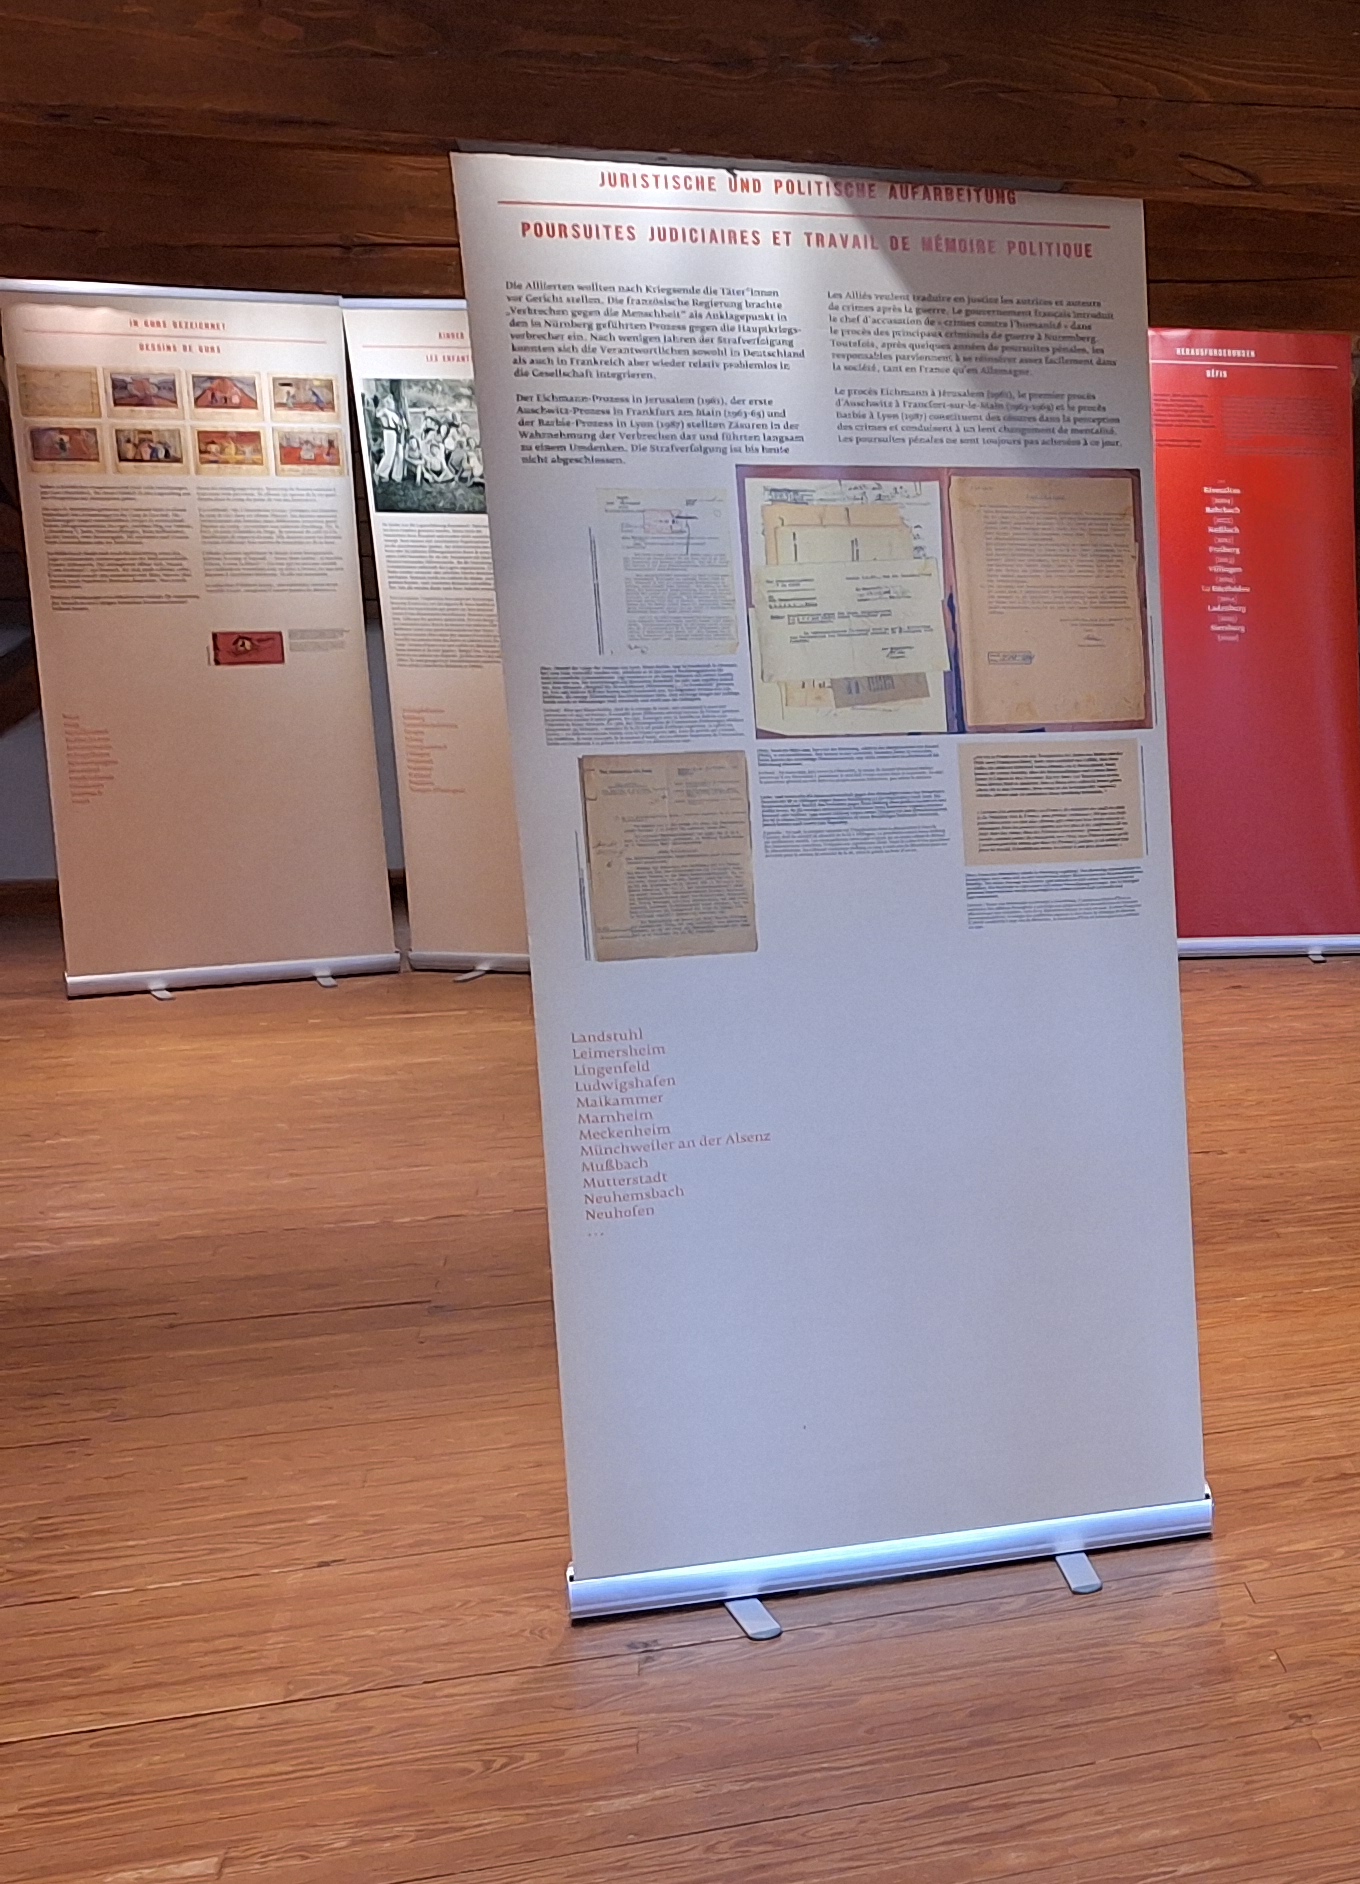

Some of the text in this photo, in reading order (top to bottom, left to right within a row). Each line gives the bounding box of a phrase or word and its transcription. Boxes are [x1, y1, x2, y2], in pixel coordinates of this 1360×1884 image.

[600, 172, 1017, 205] JURISTISCHE UND POLITISCHE AUFARBEITUNG
[521, 220, 1091, 258] POURSUITES JUDICIAIRES ET TRAVAIL DE MÉMOIRE POLITIQUE
[506, 279, 522, 289] Die
[526, 280, 574, 291] Alliierten
[618, 282, 642, 293] nach
[703, 285, 717, 295] die
[526, 292, 563, 303] Gericht
[608, 294, 624, 305] Die
[627, 295, 689, 307] französische
[692, 297, 742, 311] Regierung
[745, 298, 782, 310] brachte
[512, 354, 527, 365] als
[529, 355, 554, 365] auch
[557, 355, 567, 365] in
[570, 356, 625, 367] Frankreich
[628, 357, 648, 367] aber
[652, 357, 684, 368] wieder
[689, 358, 719, 368] relativ
[833, 361, 841, 371] la
[883, 362, 902, 372] tant
[920, 363, 950, 374] France
[514, 367, 656, 382] die Gesellschaft integrieren.
[572, 1029, 642, 1043] Landstuhl
[573, 1044, 665, 1059] Leimersheim
[574, 1061, 649, 1078] Lingenfeld
[576, 1075, 675, 1094] Ludwigshafen
[577, 1092, 663, 1108] Maikammer
[578, 1109, 652, 1124] Marnheim
[579, 1124, 670, 1140] Meckenheim
[581, 1130, 770, 1156] Münchweiler an der Alsenz
[582, 1157, 648, 1172] Mußbach
[583, 1171, 666, 1188] Mutterstadt
[585, 1186, 684, 1204] Neuhemsbach
[586, 1204, 654, 1220] Neuhofen
